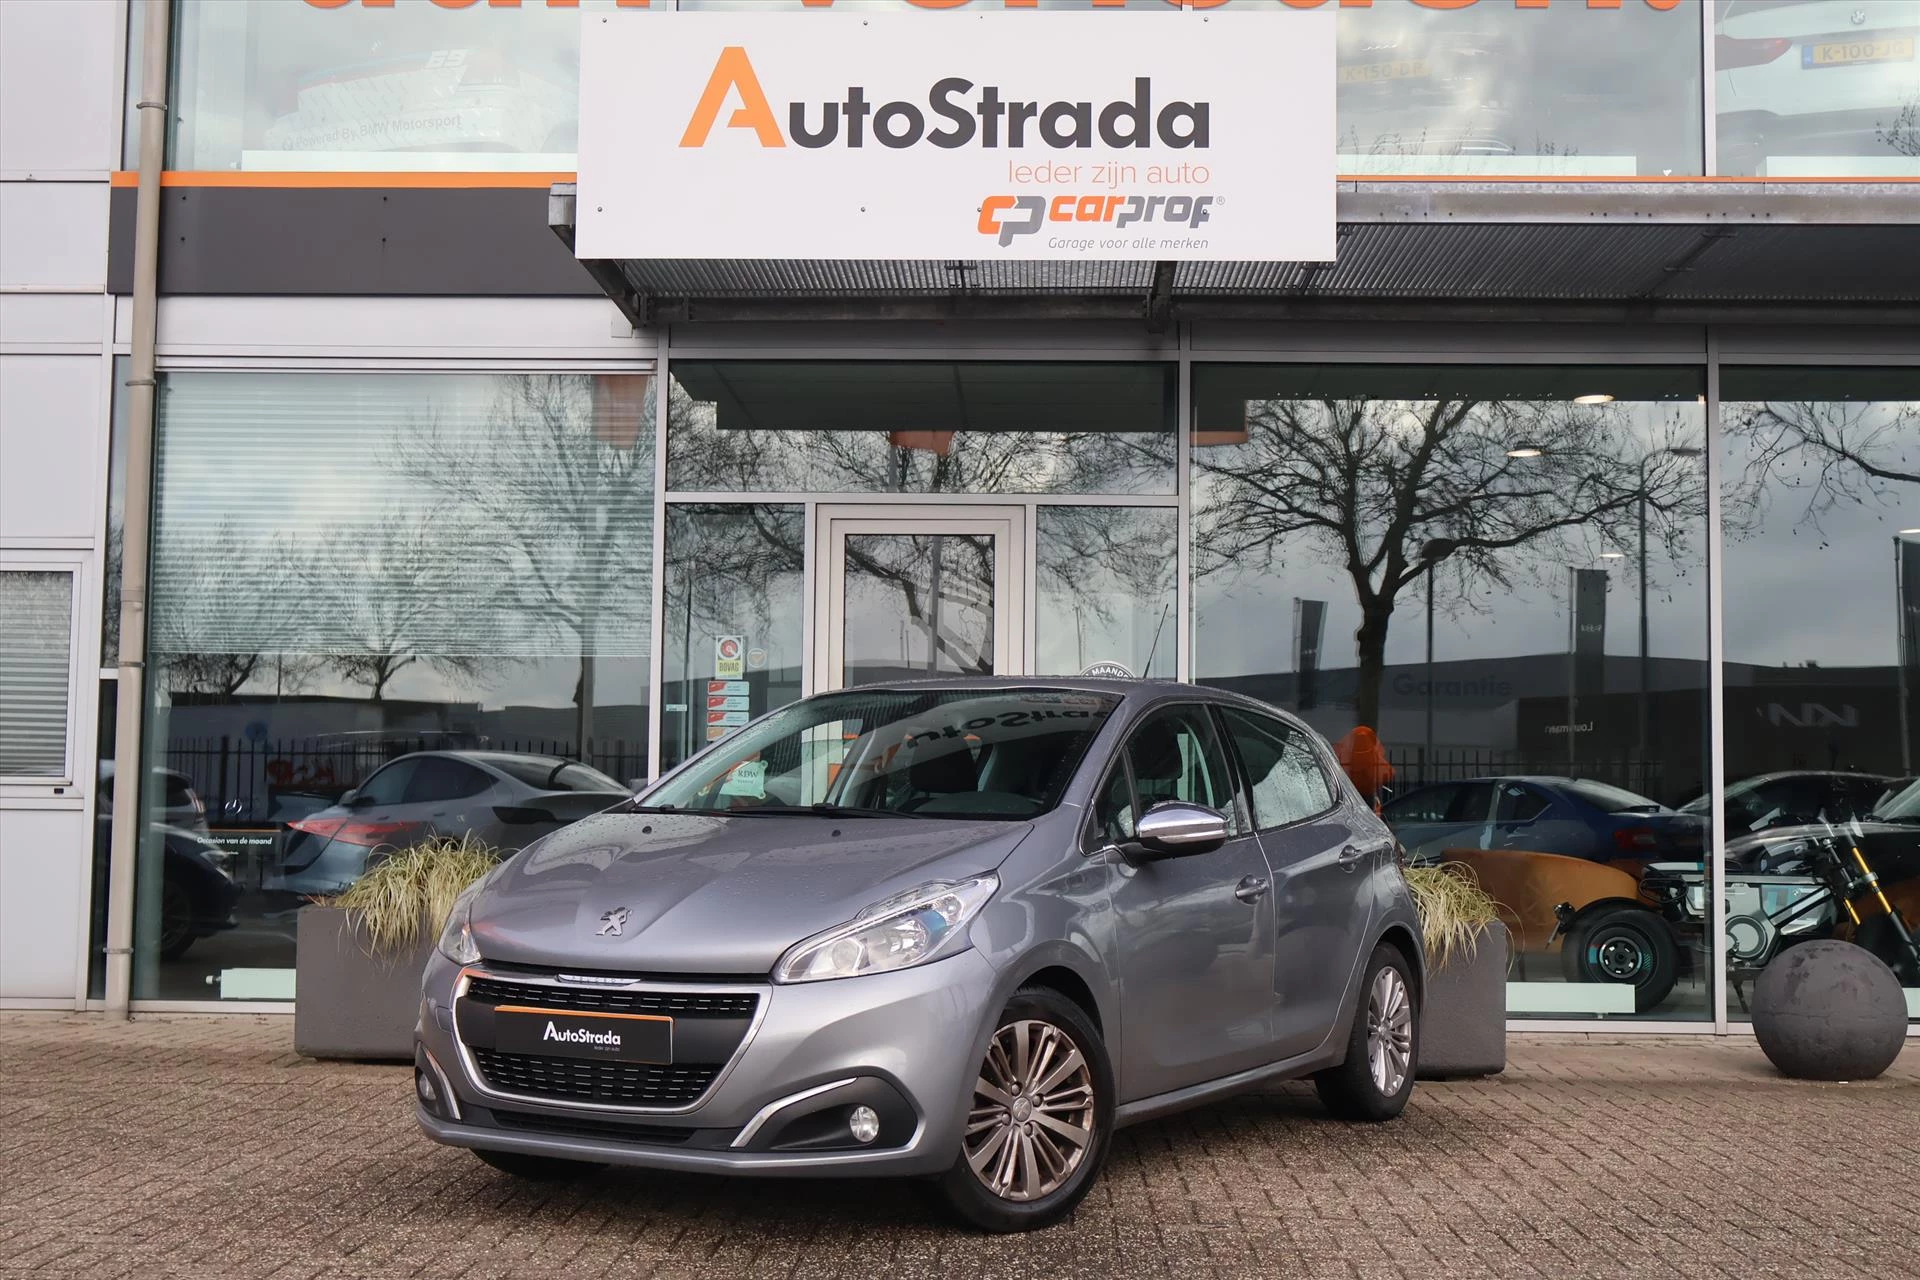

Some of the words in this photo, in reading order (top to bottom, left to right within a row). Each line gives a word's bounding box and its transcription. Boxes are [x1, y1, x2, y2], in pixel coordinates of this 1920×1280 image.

[678, 46, 1210, 149] AutoStrada
[360, 120, 389, 137] BMW
[393, 113, 462, 133] Motorsport
[1008, 160, 1082, 184] Ieder
[1091, 161, 1136, 189] zijn
[1147, 162, 1210, 184] auto
[1048, 237, 1095, 251] Garage
[1100, 240, 1129, 249] voor
[1132, 237, 1157, 249] alle
[1160, 237, 1209, 249] merken
[1393, 672, 1513, 697] Garantie
[226, 837, 239, 845] van
[239, 836, 248, 845] de
[248, 836, 273, 845] maand
[543, 1020, 621, 1046] AutoStrada
